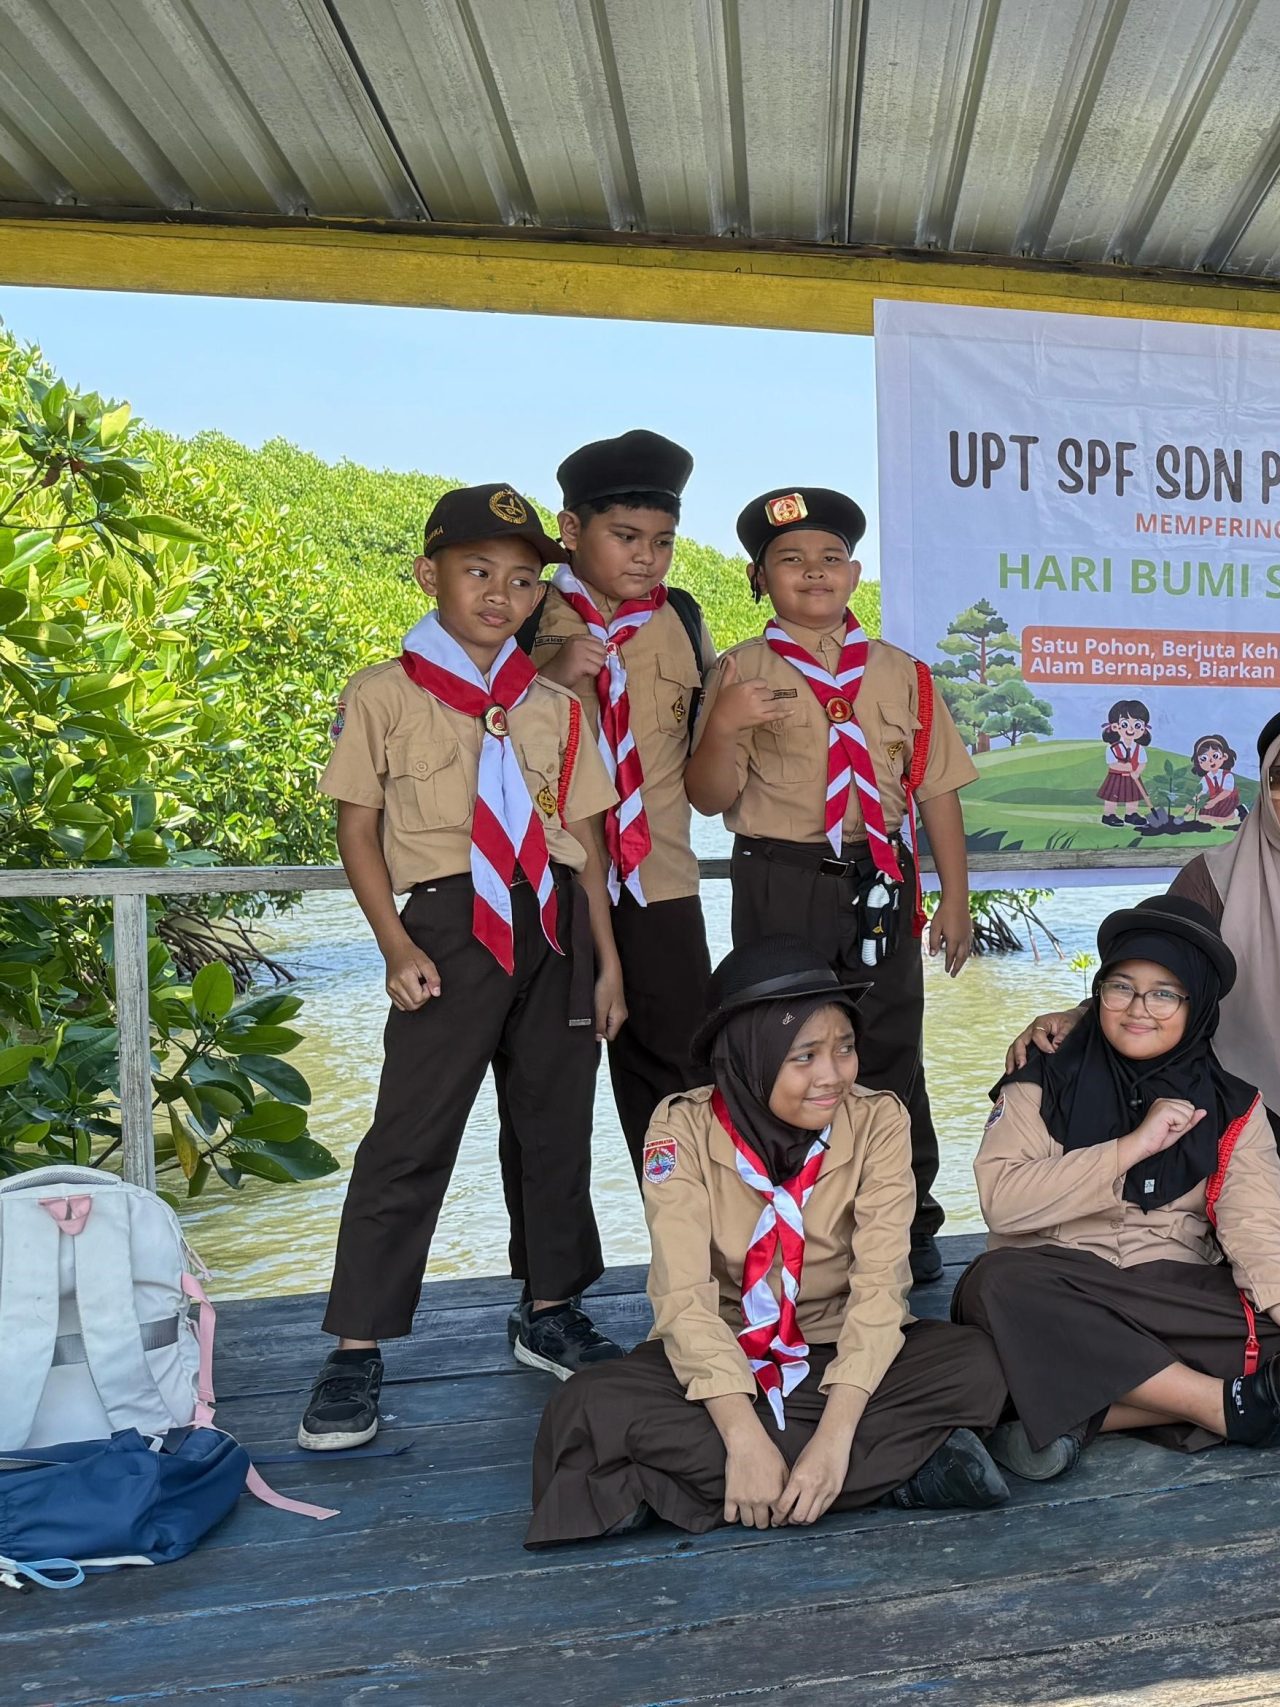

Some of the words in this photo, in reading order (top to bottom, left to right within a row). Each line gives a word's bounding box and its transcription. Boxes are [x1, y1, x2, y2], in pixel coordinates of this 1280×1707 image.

[949, 431, 1039, 491] UPT
[1057, 438, 1137, 497] SPF
[1156, 444, 1243, 503] SDN
[999, 553, 1112, 593] HARI
[1131, 558, 1250, 598] BUMI
[1031, 636, 1078, 655] Satu
[1085, 638, 1156, 659] Pohon,
[1162, 640, 1235, 662] Berjuta
[1030, 657, 1084, 675] Alam
[1091, 658, 1192, 681] Bernapas,
[1199, 661, 1275, 679] Biarkan
